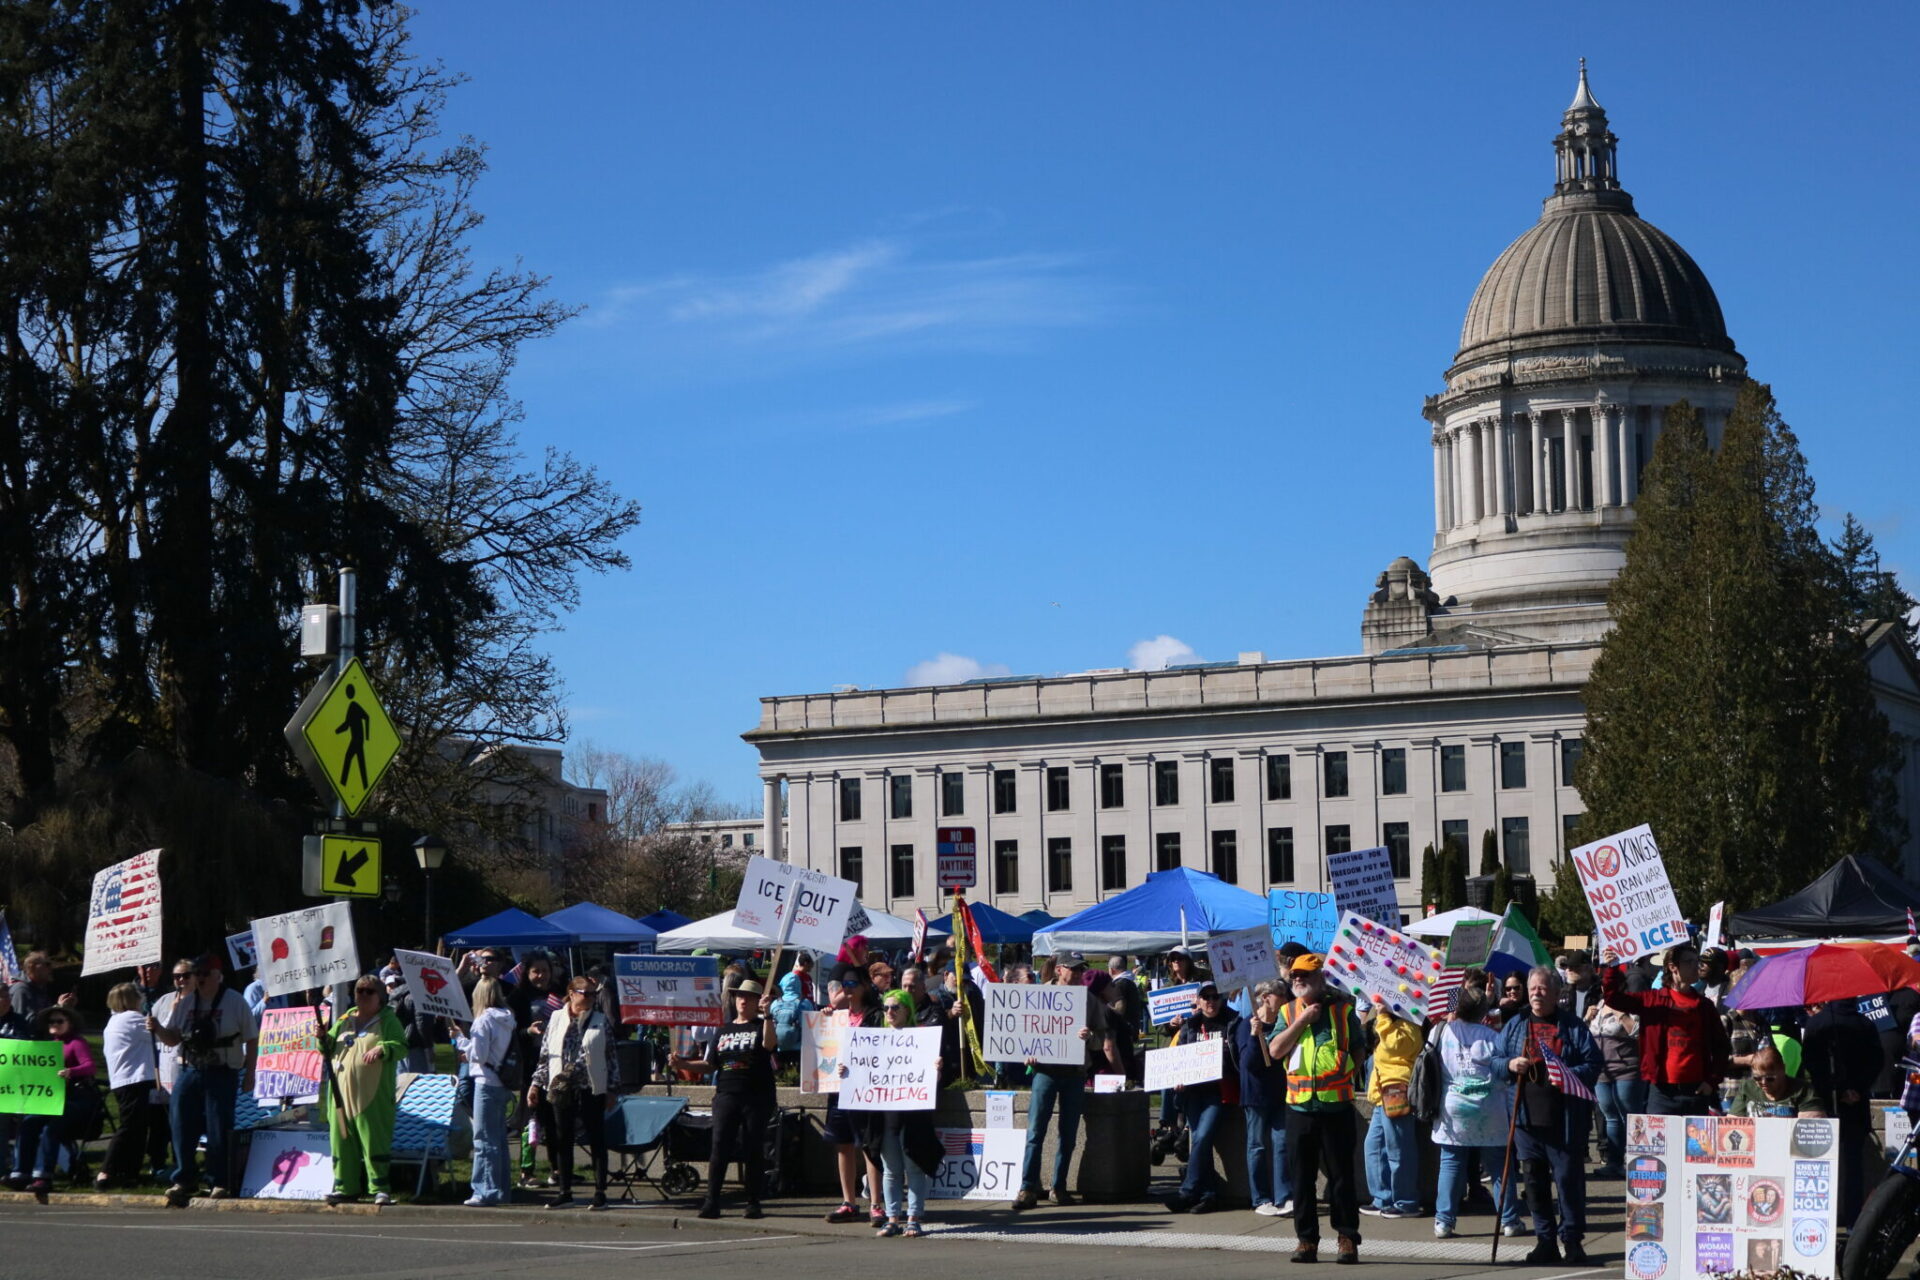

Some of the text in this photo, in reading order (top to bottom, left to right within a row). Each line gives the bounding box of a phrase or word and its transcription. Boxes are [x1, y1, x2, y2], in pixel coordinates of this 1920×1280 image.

[950, 831, 962, 842] NO
[955, 842, 974, 854] KING
[1618, 832, 1659, 869] KINGS
[939, 860, 974, 871] ANYTIME
[1329, 849, 1381, 866] FIGHTING FOR
[779, 863, 792, 876] NO
[1331, 866, 1361, 878] FREEDOM
[1364, 863, 1378, 872] PUT
[1344, 879, 1359, 888] THIS
[1362, 873, 1382, 884] CHAIR
[1588, 865, 1663, 906] NO IRAN WAR
[758, 879, 840, 917] ICE OUT
[1283, 890, 1329, 912] STOP
[1336, 892, 1350, 901] AND
[1356, 889, 1372, 897] WILL
[1373, 885, 1386, 893] USE
[1347, 902, 1360, 910] RUN
[1361, 898, 1378, 907] OVER
[1595, 888, 1656, 924] NO EPSTEIN
[271, 912, 298, 929] SAME
[774, 904, 784, 920] 4
[794, 910, 819, 927] GOOD
[1602, 904, 1676, 942] NO OLIGARCHS
[1306, 931, 1333, 951] Medi
[1607, 938, 1638, 958] NO
[1640, 922, 1673, 950] ICE
[1360, 931, 1425, 971] FREE BALLS
[274, 958, 348, 984] DIFFERENT HATS
[630, 960, 696, 972] DEMOCRACY
[656, 979, 679, 992] NOT
[425, 994, 449, 1006] NOT
[992, 989, 1074, 1012] NO KINGS
[1376, 985, 1408, 1005] THEIRS
[1871, 996, 1884, 1009] OF
[421, 1002, 463, 1018] BOOTS
[991, 1013, 1074, 1035] NO TRUMP
[720, 1031, 758, 1041] HANDS
[850, 1030, 919, 1049] America,
[990, 1036, 1015, 1055] NO
[1019, 1037, 1053, 1056] WAR
[0, 1053, 57, 1067] O KINGS
[850, 1052, 913, 1070] have you
[255, 1071, 318, 1098] EVERYWHERE
[869, 1068, 926, 1086] learned
[0, 1083, 54, 1097] st. 1776
[851, 1086, 928, 1104] NOTHING
[1717, 1117, 1754, 1126] ANTIFA
[1717, 1157, 1753, 1165] ANTIFA
[932, 1159, 1016, 1191] RESIST
[1628, 1171, 1666, 1180] VETERANS
[1631, 1180, 1664, 1188] AGAINST
[1633, 1187, 1660, 1197] TRUMP
[1795, 1179, 1829, 1193] BAD
[1795, 1198, 1828, 1209] HOLY
